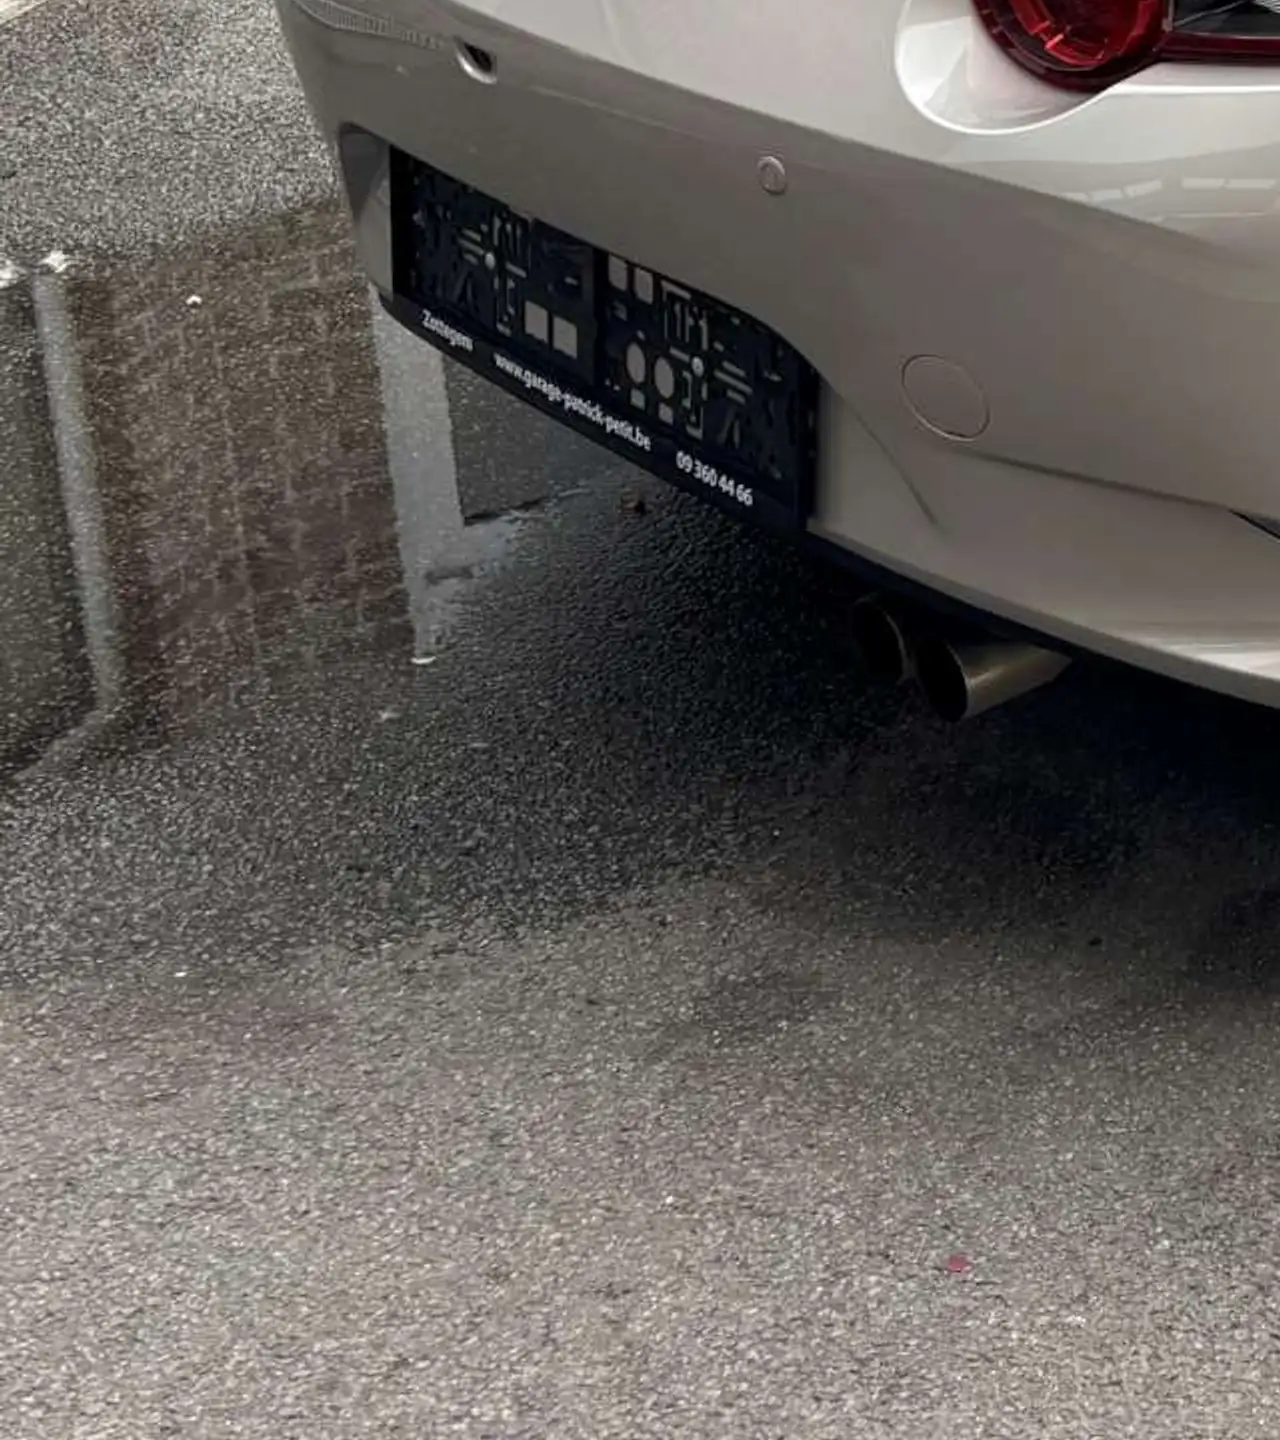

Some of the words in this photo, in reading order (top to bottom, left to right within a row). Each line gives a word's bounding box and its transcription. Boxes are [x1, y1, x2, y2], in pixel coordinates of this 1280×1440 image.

[493, 352, 652, 451] www.garage-patrick-petit.be
[676, 450, 693, 473] 09
[693, 458, 717, 487] 360
[718, 473, 735, 497] 44
[736, 483, 753, 506] 66
